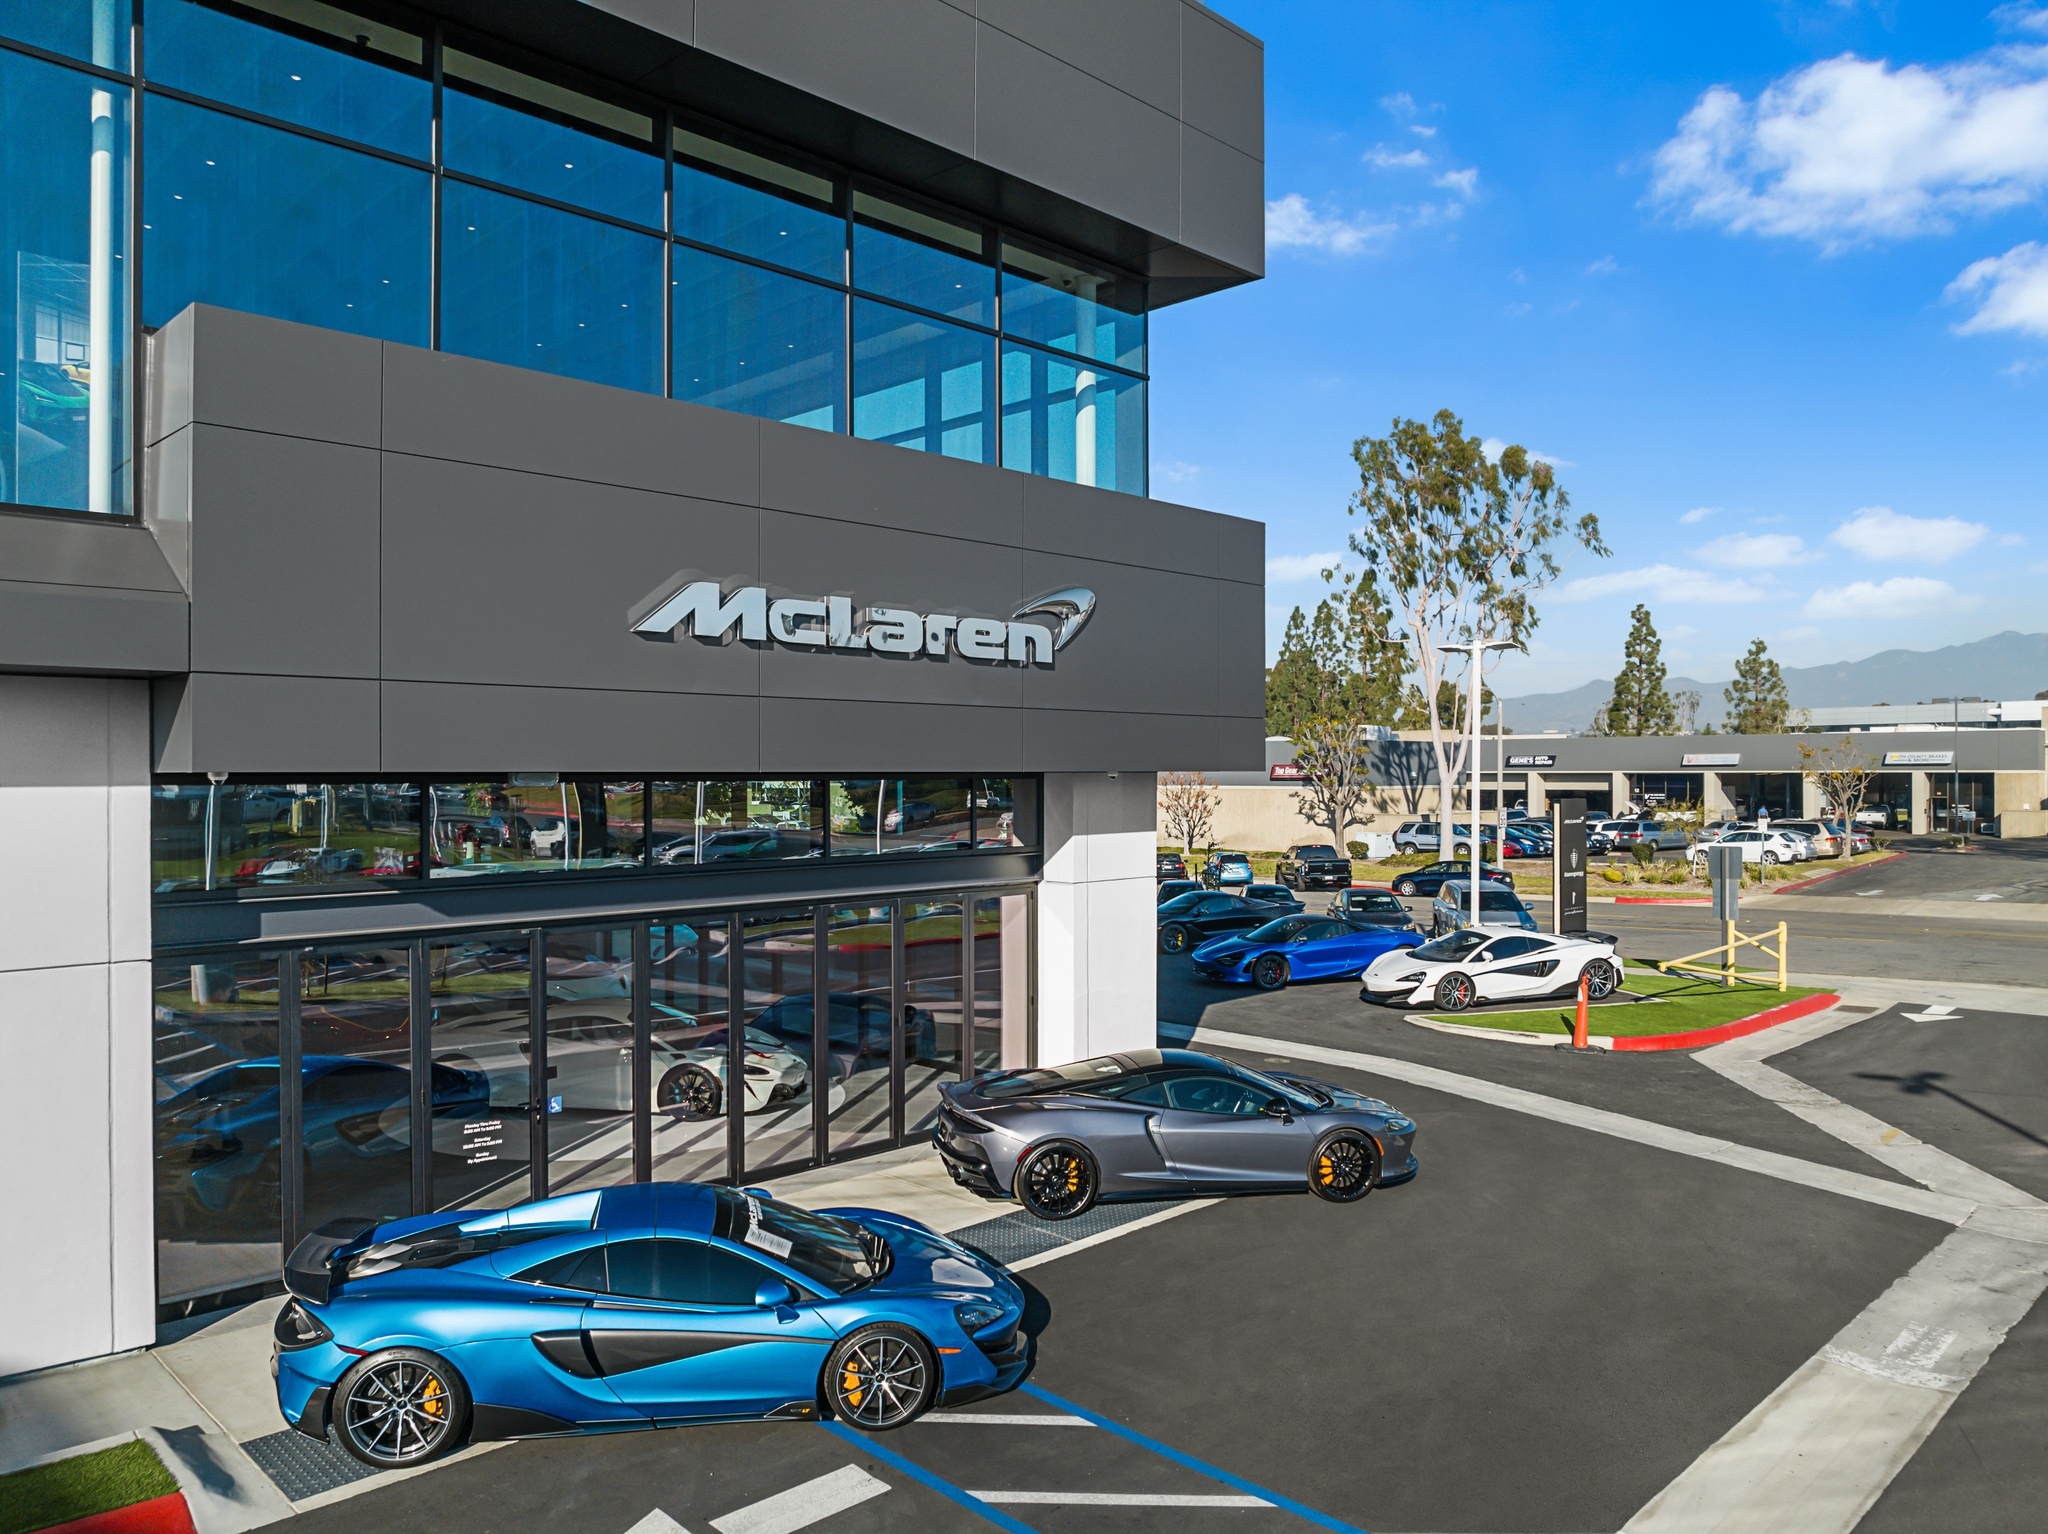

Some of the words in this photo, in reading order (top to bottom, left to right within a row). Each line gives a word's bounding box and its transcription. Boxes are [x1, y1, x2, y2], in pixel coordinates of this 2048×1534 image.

[631, 580, 1054, 665] McLaren
[1275, 766, 1285, 775] Top
[1285, 766, 1299, 774] Gear
